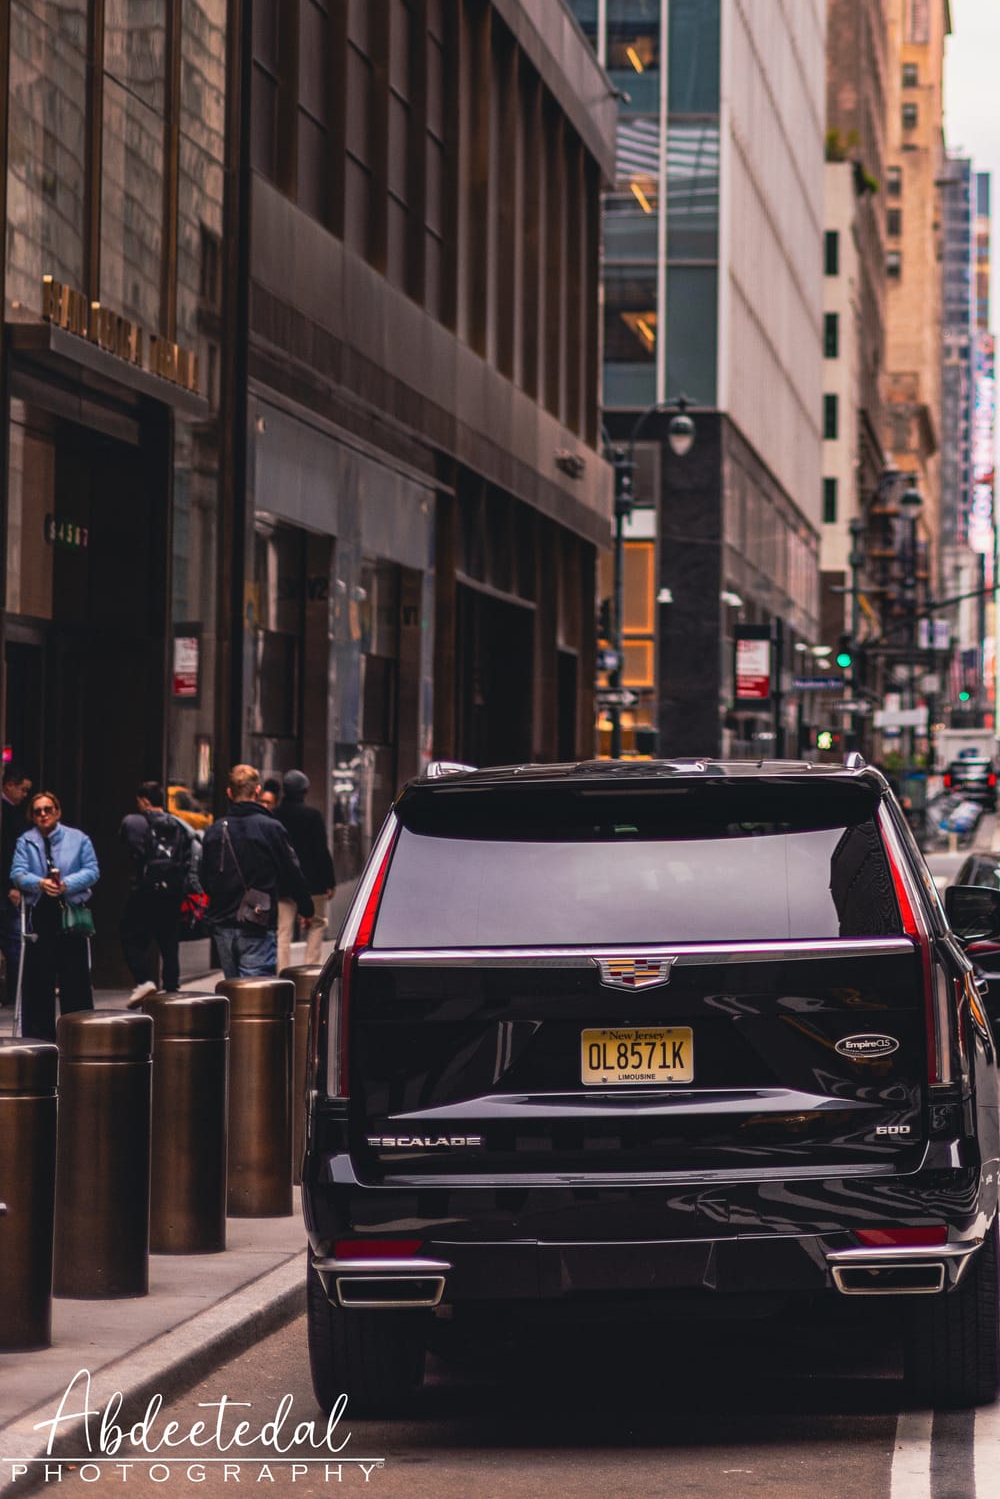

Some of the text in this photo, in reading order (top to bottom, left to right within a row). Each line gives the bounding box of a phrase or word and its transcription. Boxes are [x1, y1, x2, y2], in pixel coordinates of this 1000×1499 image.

[609, 1030, 664, 1042] New Jersey
[618, 1073, 656, 1081] LIMOUSINE
[875, 1125, 911, 1135] 600
[367, 1137, 481, 1147] ESCALADE
